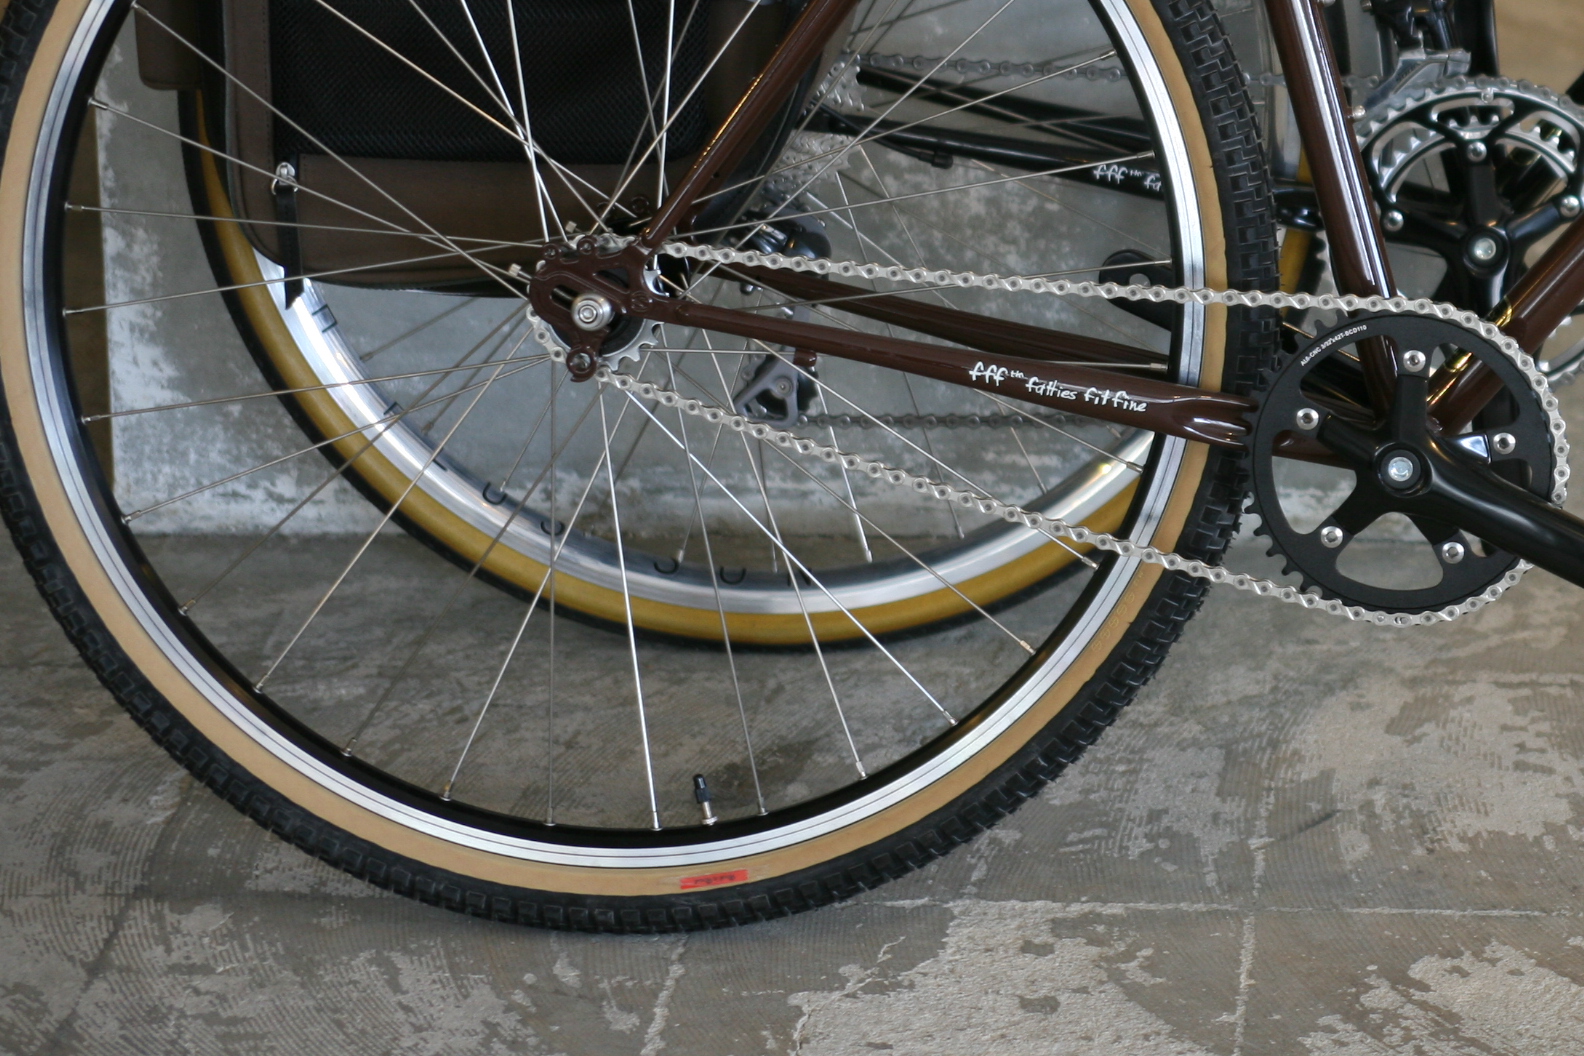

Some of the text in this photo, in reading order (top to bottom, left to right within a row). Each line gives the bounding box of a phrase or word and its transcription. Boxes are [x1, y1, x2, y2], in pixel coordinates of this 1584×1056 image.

[1025, 376, 1078, 401] fatties
[1084, 387, 1110, 406] fit
[1111, 390, 1148, 413] fine
